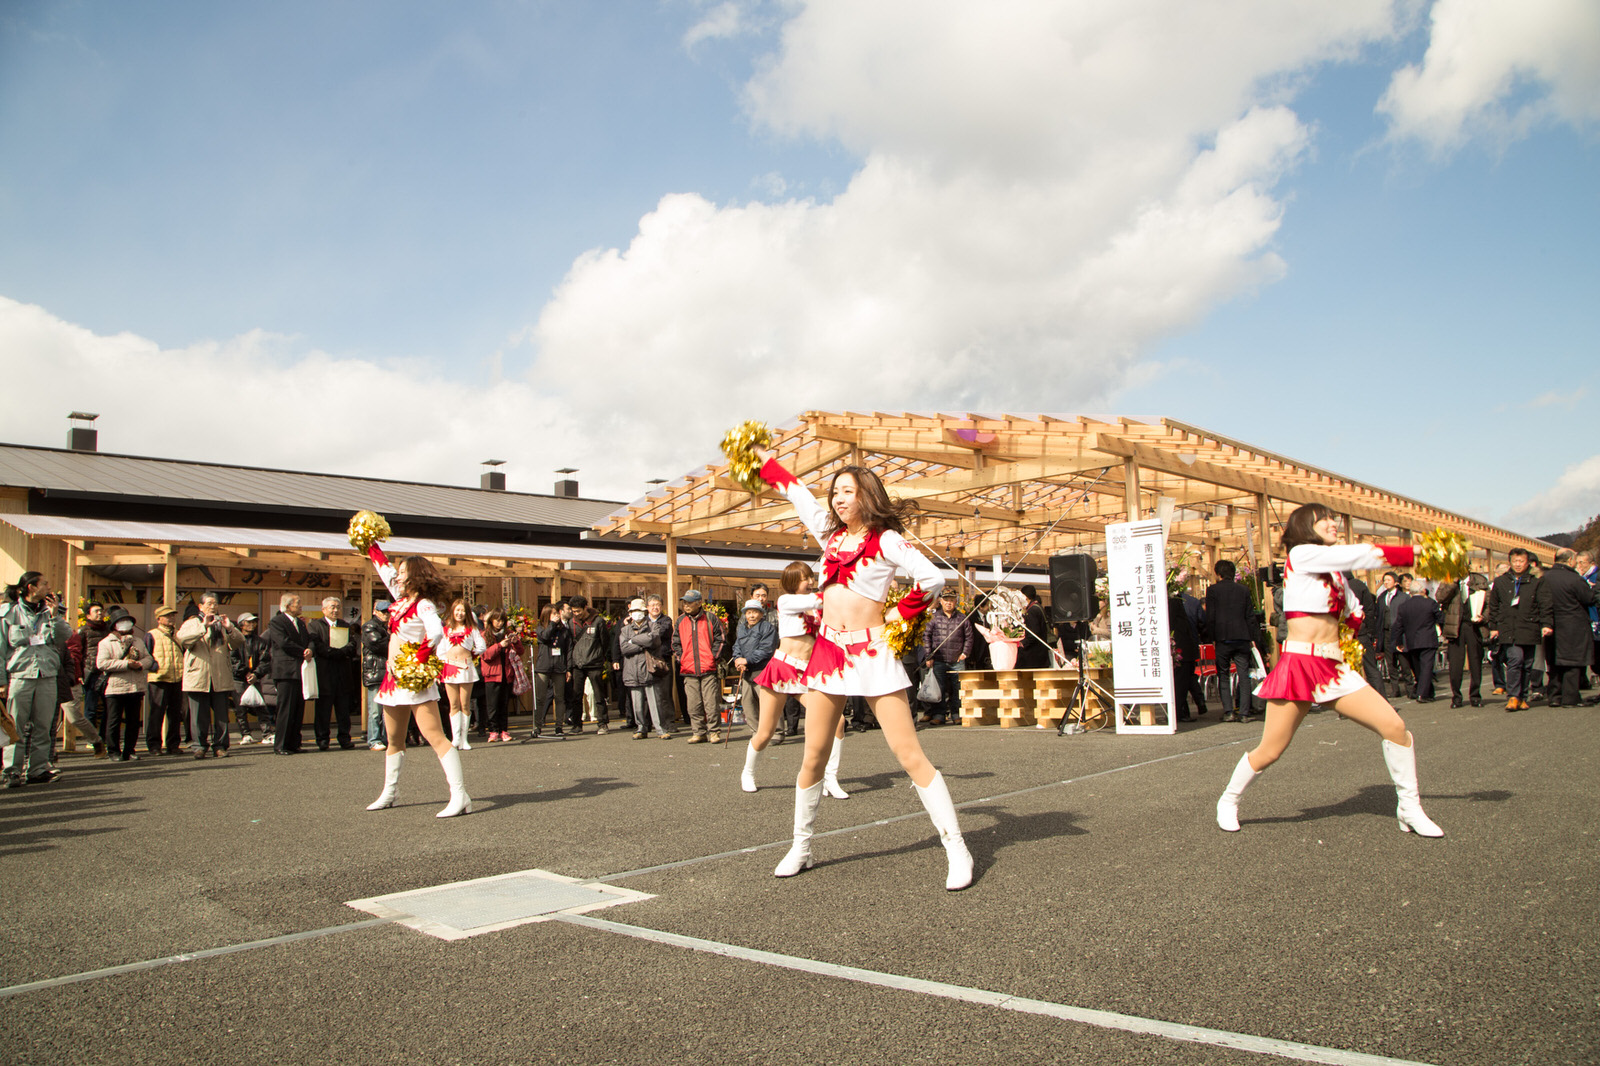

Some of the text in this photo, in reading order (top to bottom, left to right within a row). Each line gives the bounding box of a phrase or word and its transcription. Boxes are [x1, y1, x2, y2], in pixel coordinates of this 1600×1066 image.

[1116, 590, 1132, 637] 式場
[1134, 565, 1148, 677] オープニングセレモニー
[1144, 543, 1160, 677] 南三陸志津川さんさん商店街
